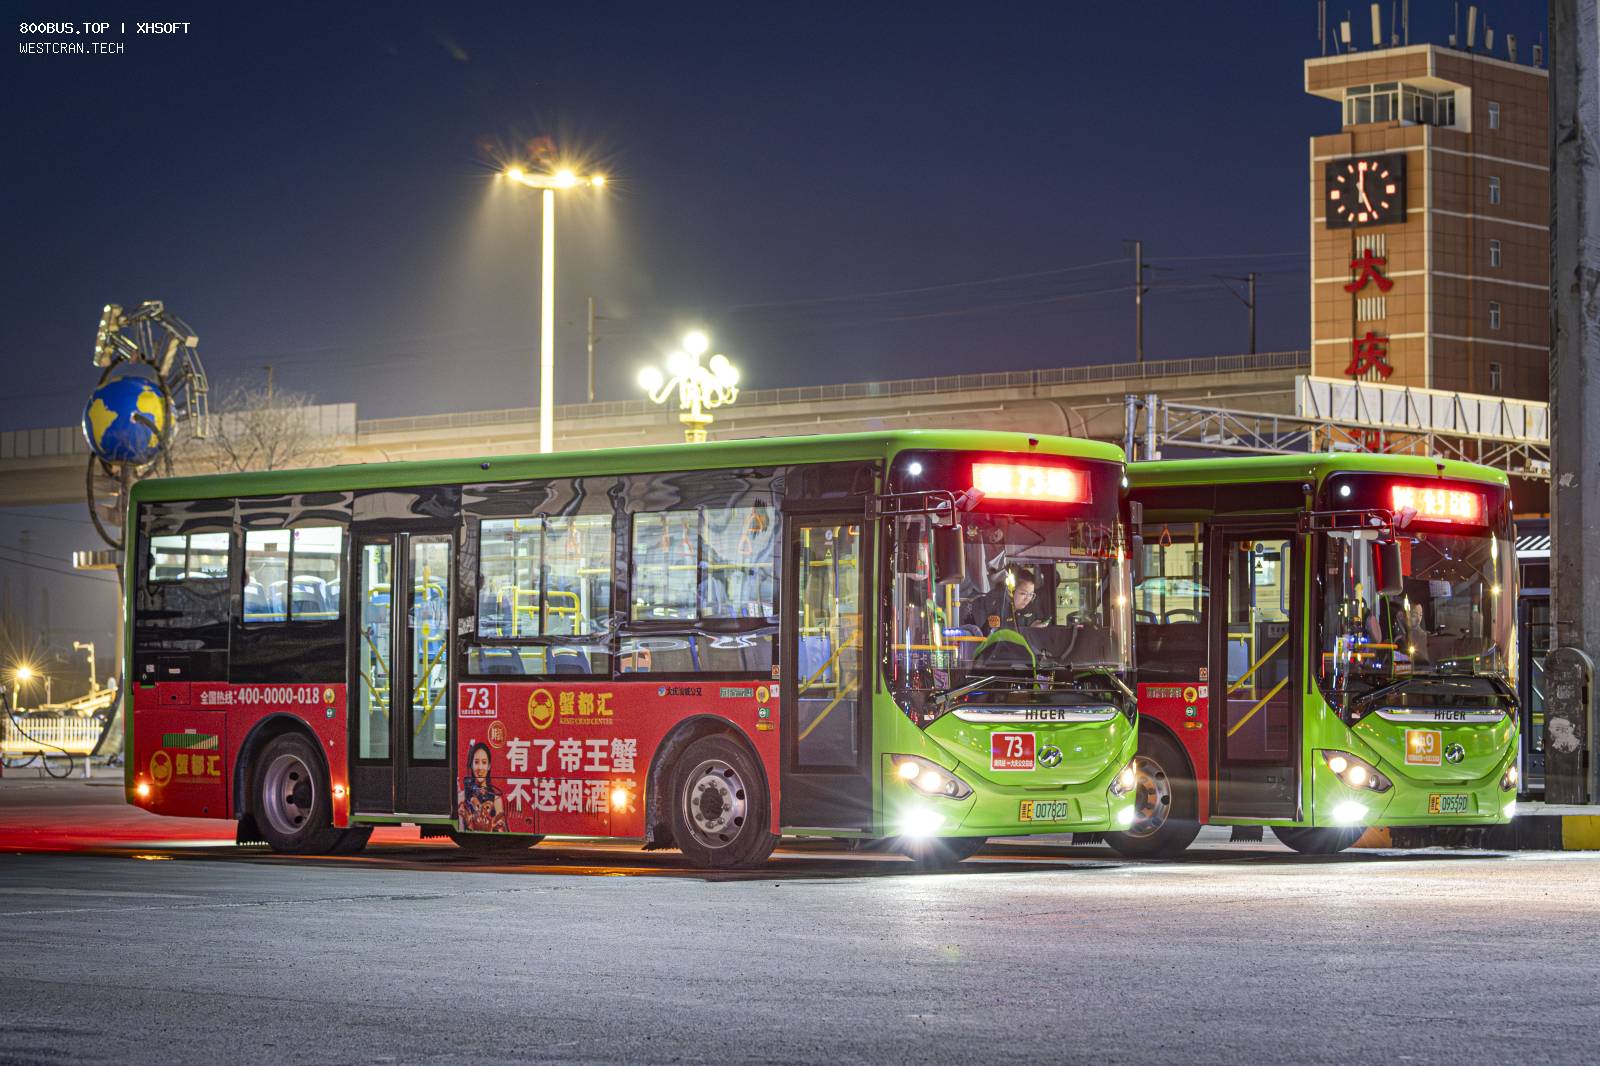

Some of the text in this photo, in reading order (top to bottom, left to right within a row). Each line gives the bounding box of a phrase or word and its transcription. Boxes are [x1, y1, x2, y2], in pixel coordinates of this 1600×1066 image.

[466, 687, 490, 709] 73
[559, 691, 614, 716] 蟹都汇
[1025, 709, 1066, 720] HIGER
[1433, 711, 1466, 721] HIGER
[506, 737, 637, 774] 有了帝王蟹
[1004, 736, 1023, 758] 73
